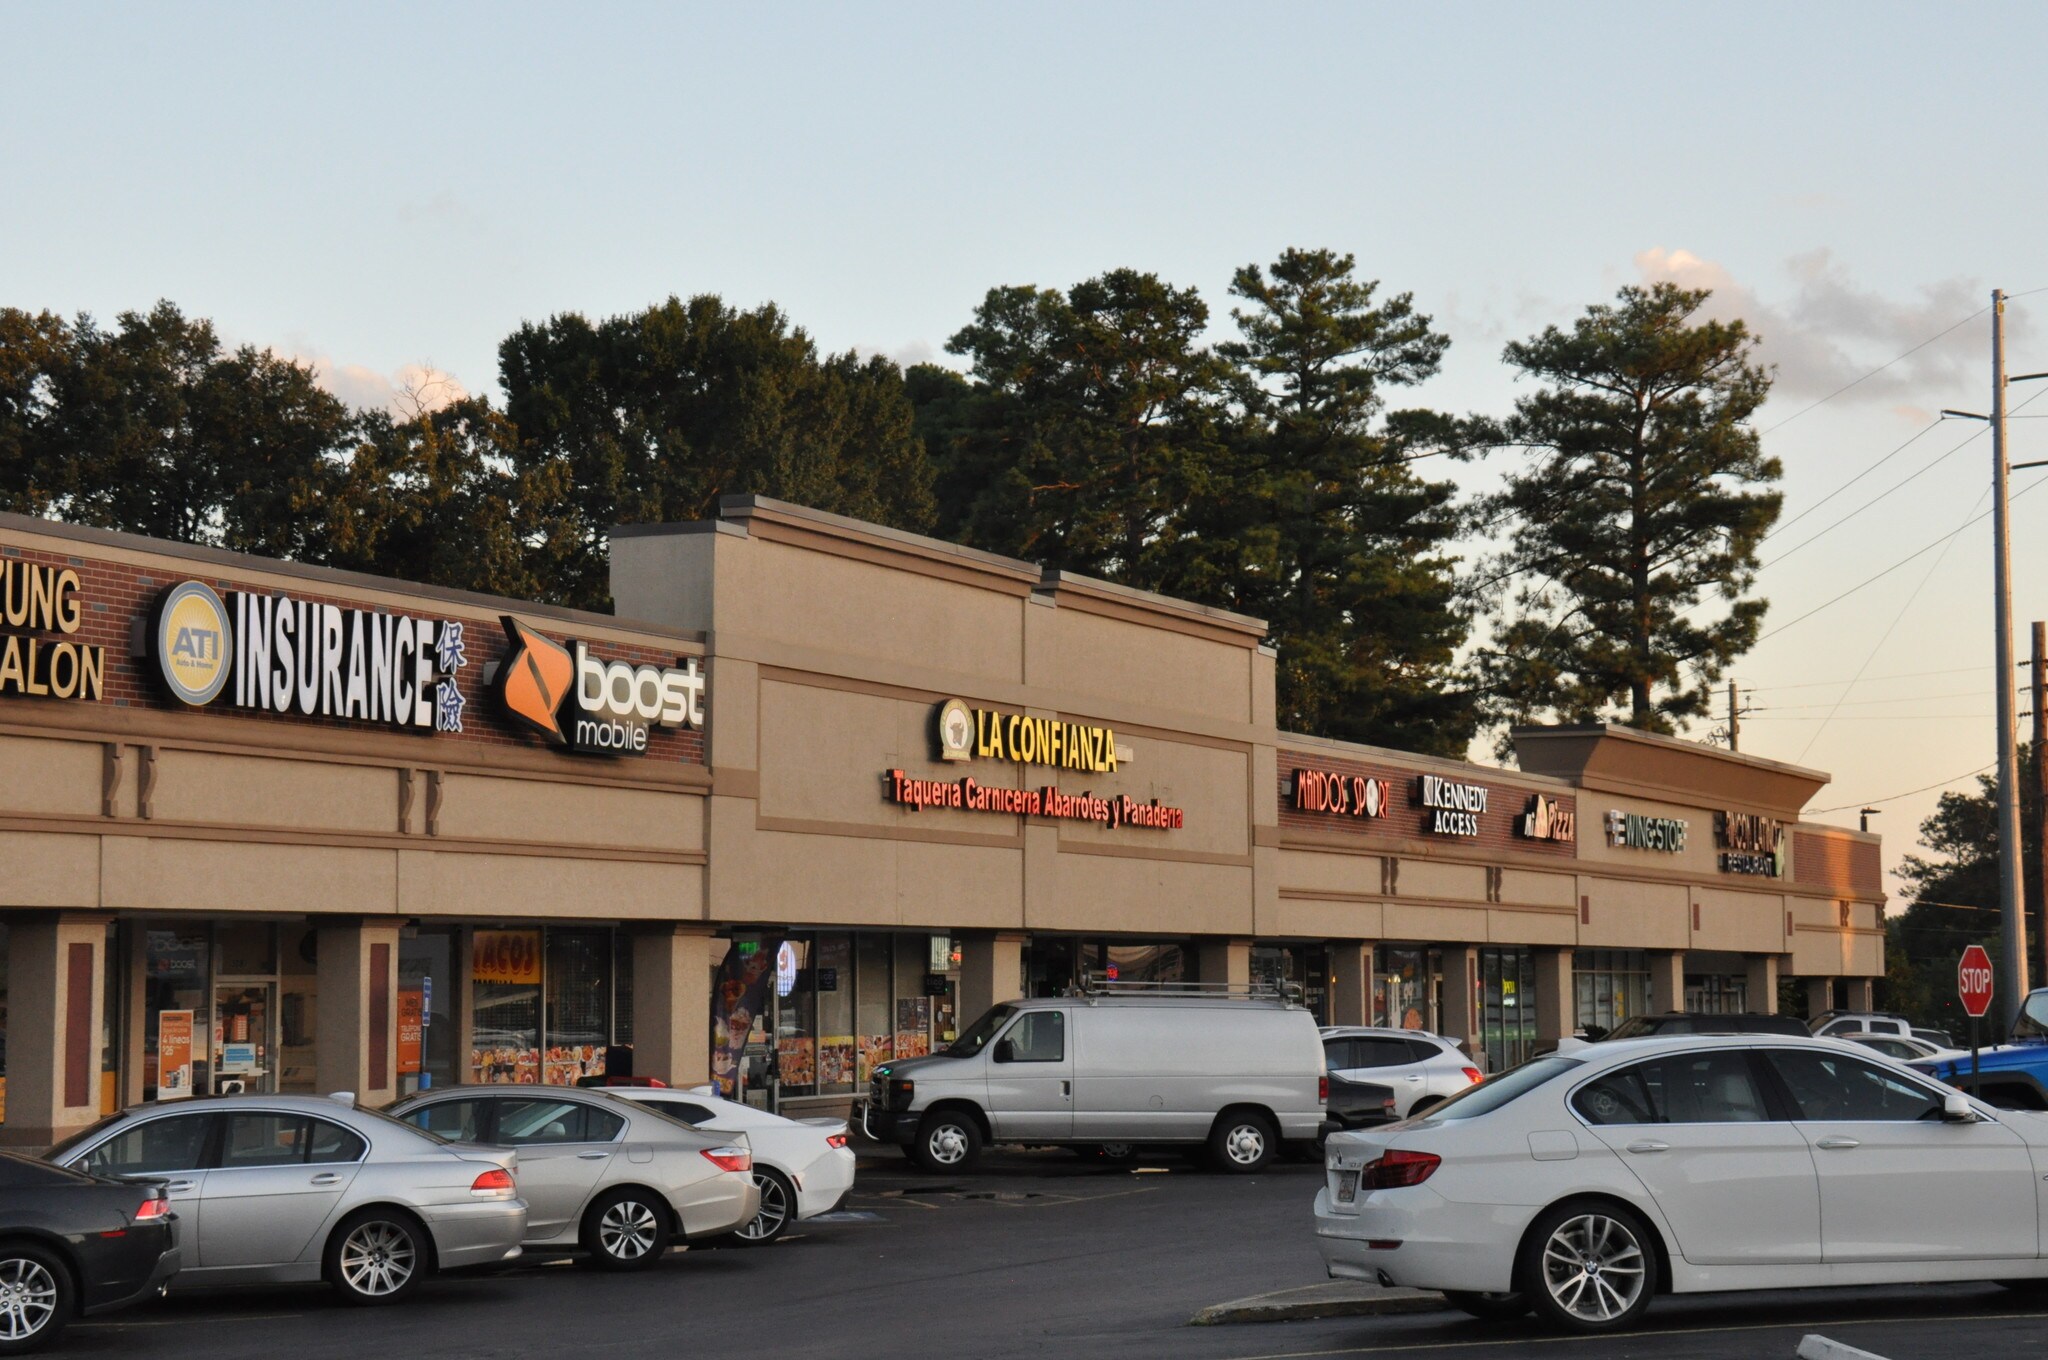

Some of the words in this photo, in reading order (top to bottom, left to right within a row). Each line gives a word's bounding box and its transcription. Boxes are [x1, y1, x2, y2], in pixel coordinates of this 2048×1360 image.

[0, 558, 81, 634] UNG
[172, 627, 219, 660] ATI
[236, 592, 434, 727] INSURANCE
[577, 644, 704, 725] boost
[577, 719, 647, 751] mobile
[977, 708, 1004, 759] LA
[1008, 714, 1118, 773] CONFIANZA
[1044, 786, 1109, 821] Abarrotes
[1112, 800, 1121, 829] y
[1434, 776, 1489, 813] KENNEDY
[1434, 810, 1478, 837] ACCESS
[1728, 852, 1773, 878] RESTAURANT
[1961, 968, 1991, 993] STOP
